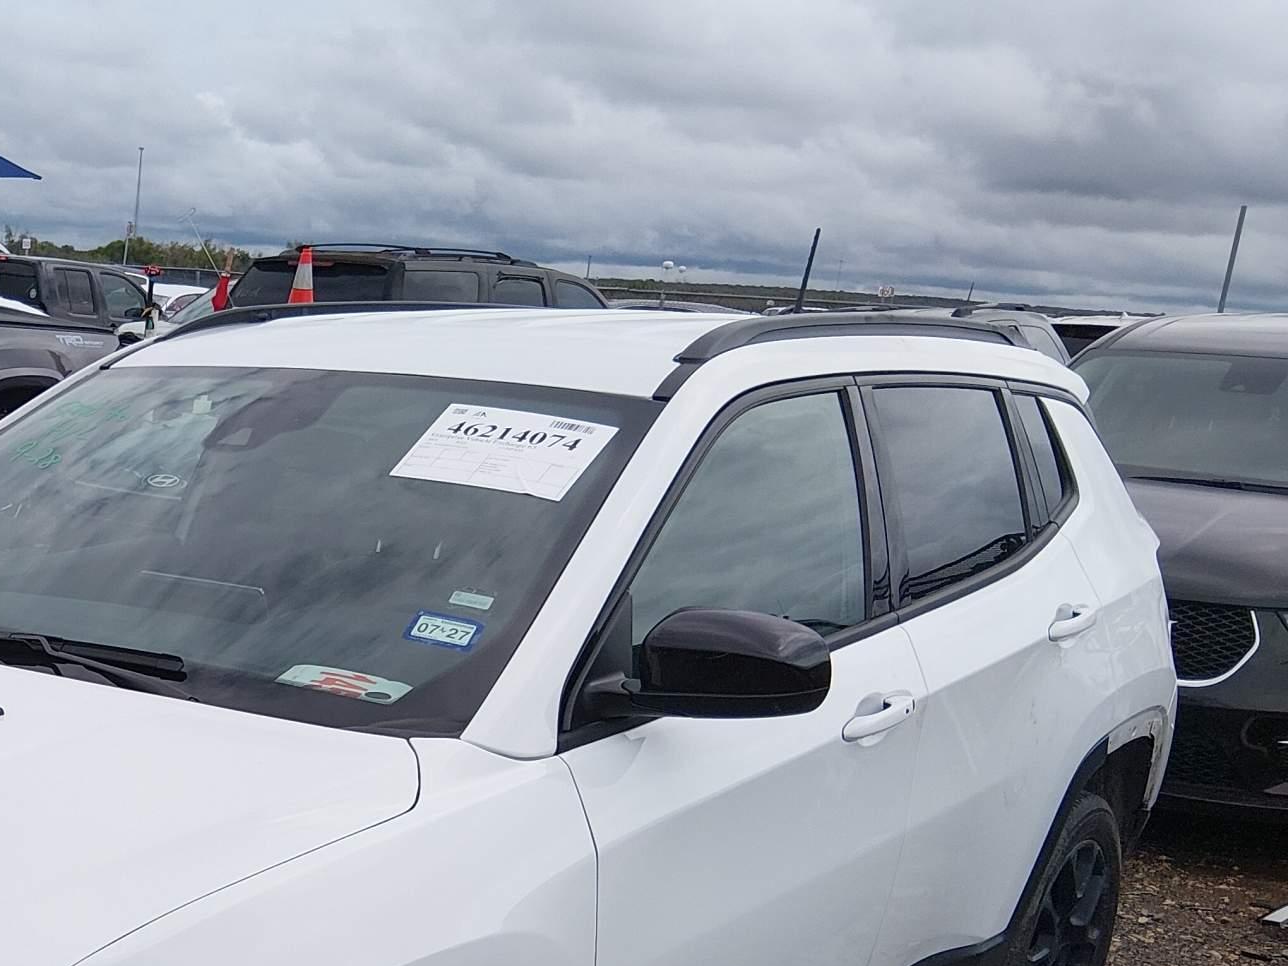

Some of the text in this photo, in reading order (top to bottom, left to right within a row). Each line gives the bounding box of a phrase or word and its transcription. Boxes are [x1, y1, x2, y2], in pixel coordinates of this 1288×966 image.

[447, 421, 583, 452] 46214074
[417, 622, 441, 635] 07
[446, 627, 471, 641] 27
